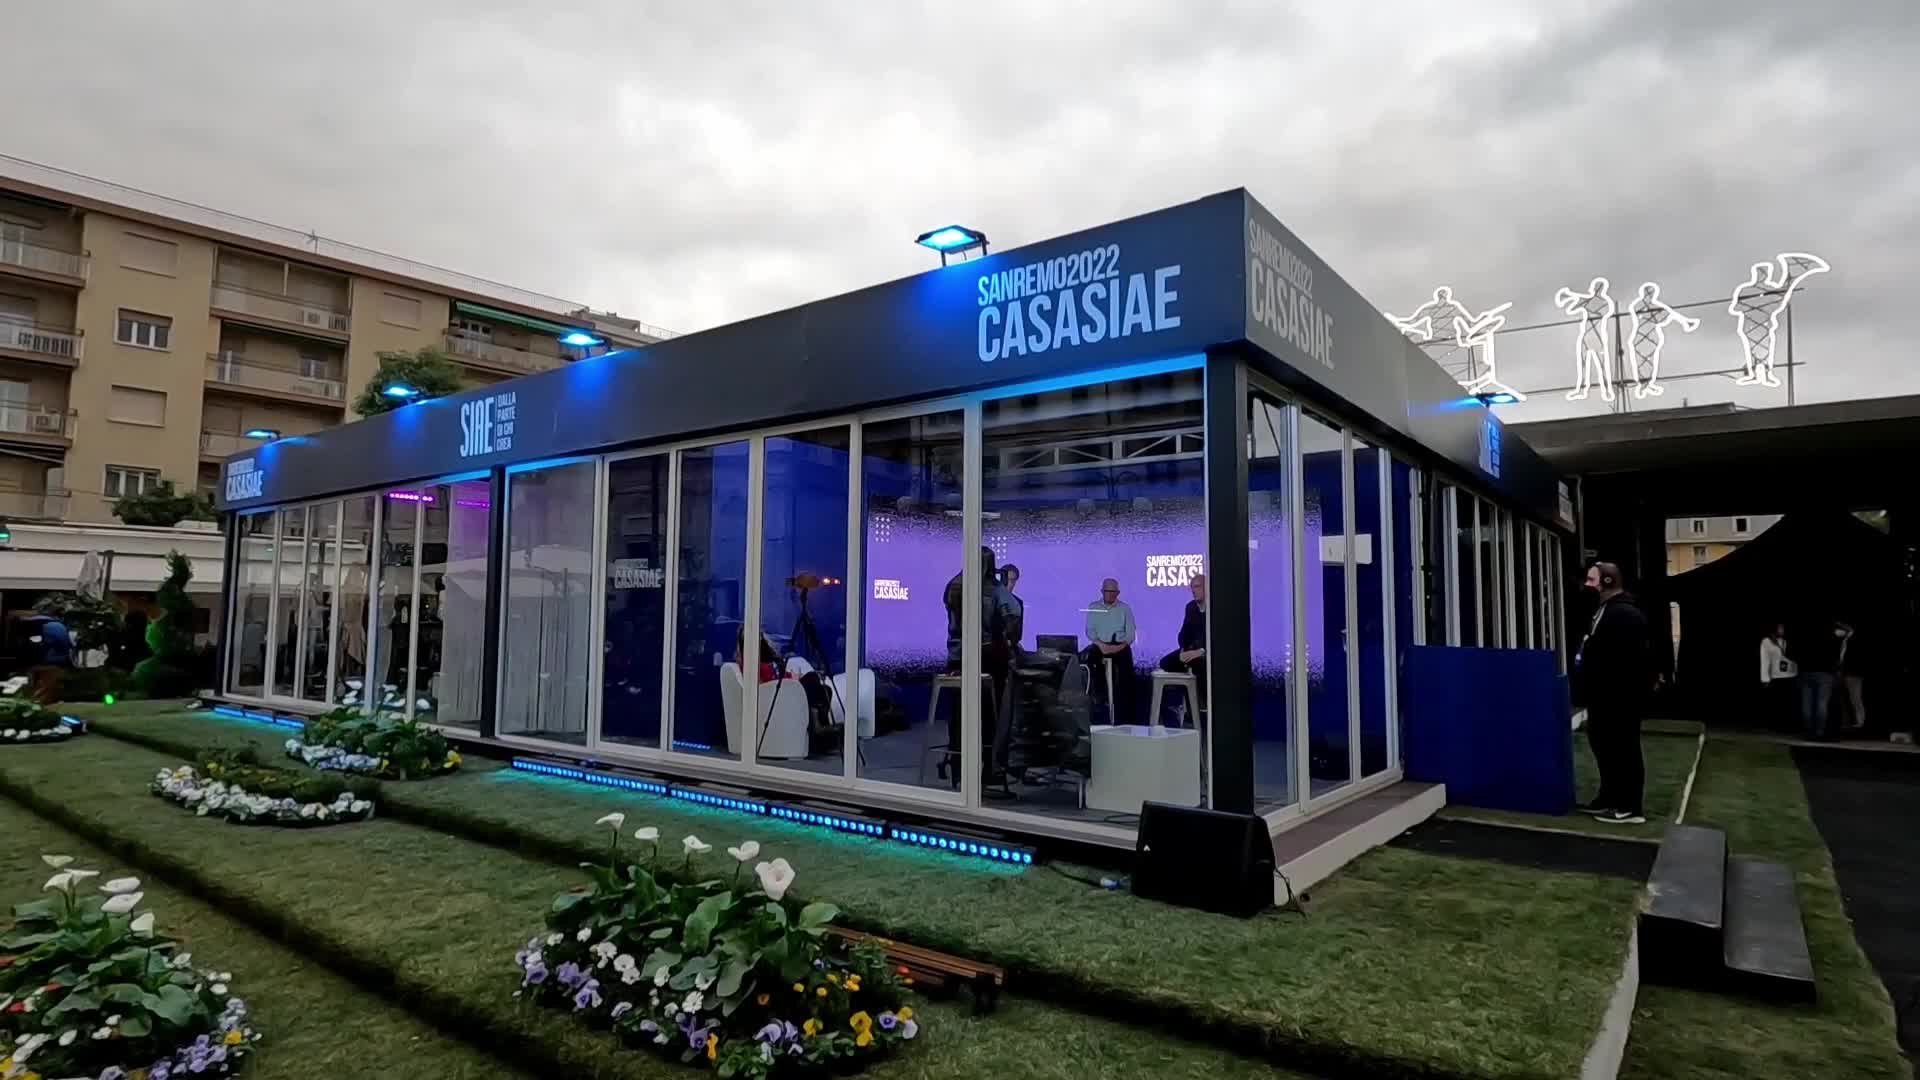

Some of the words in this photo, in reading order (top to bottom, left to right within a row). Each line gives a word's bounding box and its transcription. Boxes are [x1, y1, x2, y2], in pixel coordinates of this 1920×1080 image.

[978, 243, 1120, 306] SANREMO2022
[978, 265, 1181, 362] CASASIAE
[1251, 257, 1335, 370] CASASIAE
[460, 396, 494, 457] SIAE
[226, 470, 264, 501] CASASIAE
[1146, 554, 1203, 567] SANREMO2022
[874, 586, 909, 600] CASASIAE
